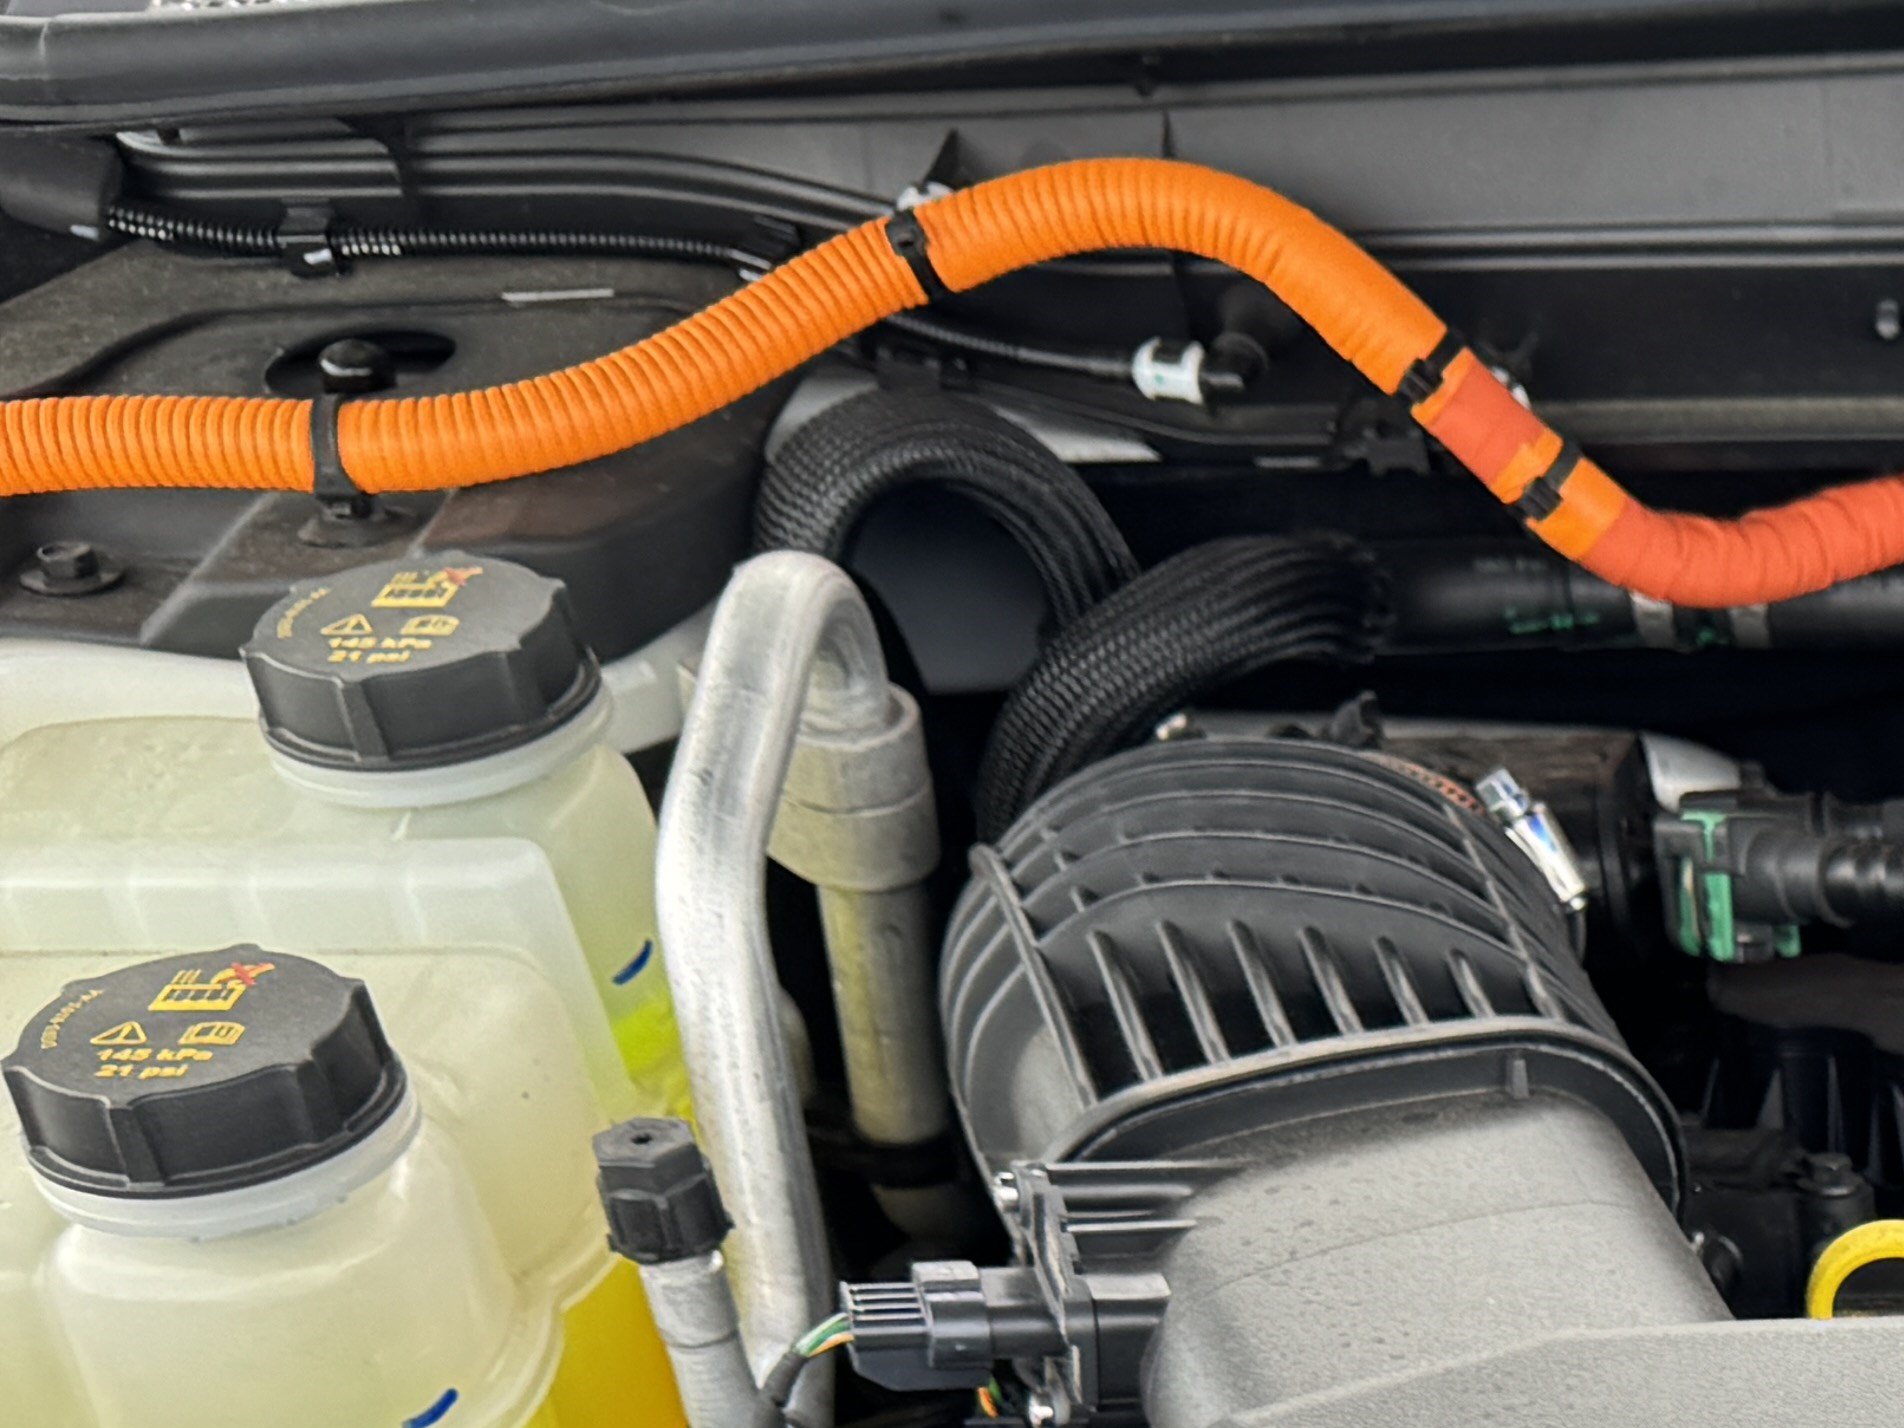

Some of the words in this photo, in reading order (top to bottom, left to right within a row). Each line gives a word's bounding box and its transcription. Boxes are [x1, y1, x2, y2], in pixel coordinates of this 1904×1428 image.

[97, 1048, 152, 1061] 145
[156, 1048, 214, 1061] kPa
[94, 1064, 134, 1078] 21
[137, 1064, 189, 1080] psi
